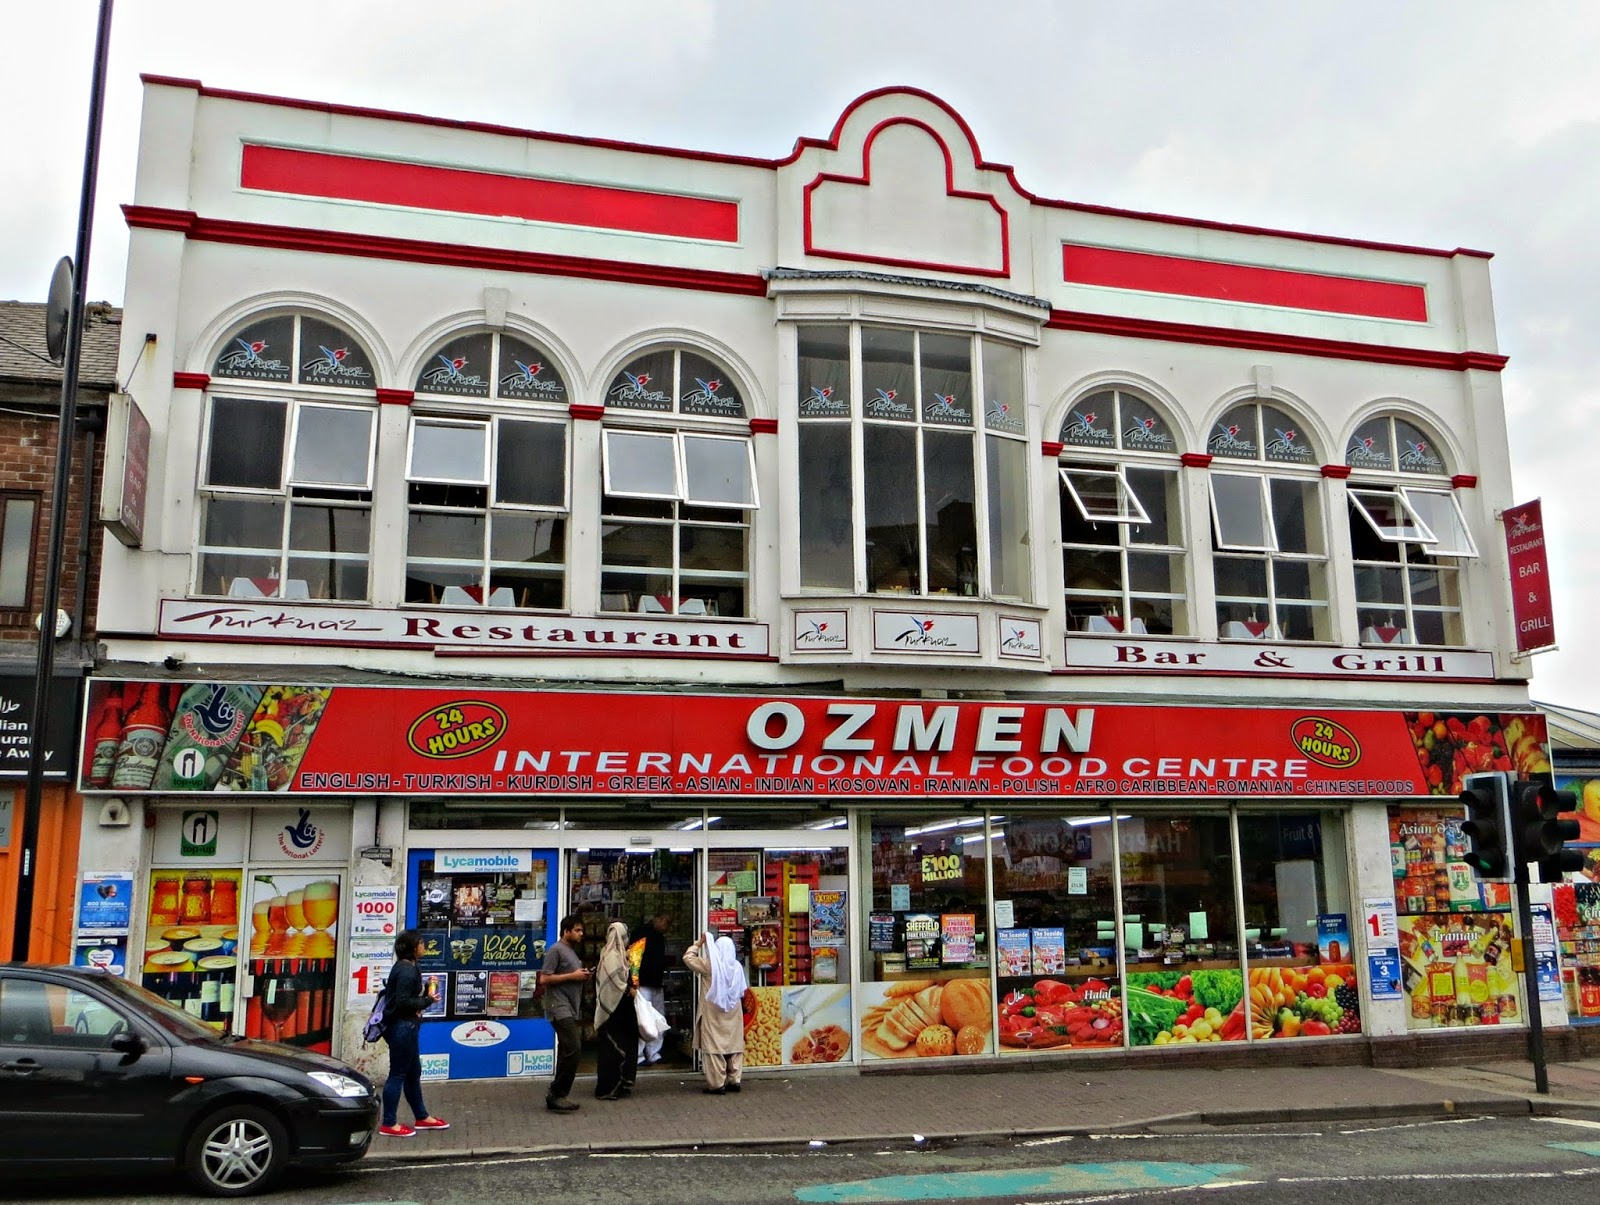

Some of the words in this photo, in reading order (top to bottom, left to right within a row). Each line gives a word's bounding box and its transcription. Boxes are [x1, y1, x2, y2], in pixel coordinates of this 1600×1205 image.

[219, 369, 288, 379] RESTAURANT
[423, 385, 490, 395] RESTAURANT
[611, 400, 671, 410] RESTAURANT
[1064, 438, 1114, 446] RESTAURANT
[1210, 449, 1257, 457] RESTAURANT
[1510, 538, 1543, 554] RESTAURANT
[1519, 562, 1540, 577] BAR
[1528, 592, 1537, 603] &
[173, 608, 383, 631] Turkuaz
[402, 615, 746, 649] Restaurant
[1520, 616, 1550, 633] GRILL
[797, 630, 845, 643] Turkuaz
[895, 629, 957, 647] Turkuaz
[1003, 637, 1039, 650] Turkuaz
[1113, 645, 1206, 665] Bar
[1254, 650, 1294, 668] &
[1332, 653, 1446, 672] Grill
[435, 708, 463, 730] 24
[189, 728, 225, 747] National
[223, 710, 246, 743] Lottery
[745, 701, 1095, 753] OZMEN
[1314, 721, 1335, 741] 24
[427, 717, 496, 755] HOURS
[6, 748, 54, 761] Awy
[1300, 736, 1352, 762] HOURS
[493, 750, 954, 776] INTERNATIONAL
[969, 756, 1107, 777] FOOD
[1122, 757, 1308, 778] CENTRE
[300, 773, 390, 789] ENGLISH
[404, 774, 492, 790] TURKISH
[508, 775, 593, 791] KURDISH
[607, 776, 673, 791] GREEK
[685, 776, 741, 791] ASIAN
[754, 777, 814, 792] INDIAN
[828, 777, 910, 792] KOSOVAN
[924, 778, 990, 792] IRANIAN
[1002, 778, 1060, 792] POLISH
[1074, 779, 1116, 793] AFRO
[1120, 779, 1208, 793] CARIBBEAN
[1217, 779, 1293, 793] ROMANIAN
[1305, 780, 1367, 793] CHINESE
[1368, 780, 1414, 793] FOODS
[1283, 828, 1306, 841] Fruit
[1399, 822, 1432, 834] Asian
[281, 844, 309, 859] National
[307, 830, 325, 857] Lottery
[591, 850, 607, 858] Baby
[444, 856, 519, 868] Lycamobile
[921, 855, 960, 872] £100
[922, 869, 963, 882] MILLION
[355, 890, 396, 898] Lycamobile
[356, 902, 395, 913] 1000
[906, 922, 939, 931] SHEFFIELD
[1368, 914, 1379, 936] 1
[1435, 930, 1479, 941] Iranian
[483, 934, 527, 952] 100%
[352, 951, 393, 959] Lycamobile
[483, 950, 526, 960] arabica
[1380, 966, 1389, 976] 3
[1008, 988, 1024, 1005] حلال
[1084, 987, 1114, 999] Halal
[525, 1054, 552, 1064] Lyca
[525, 1063, 552, 1071] mobile
